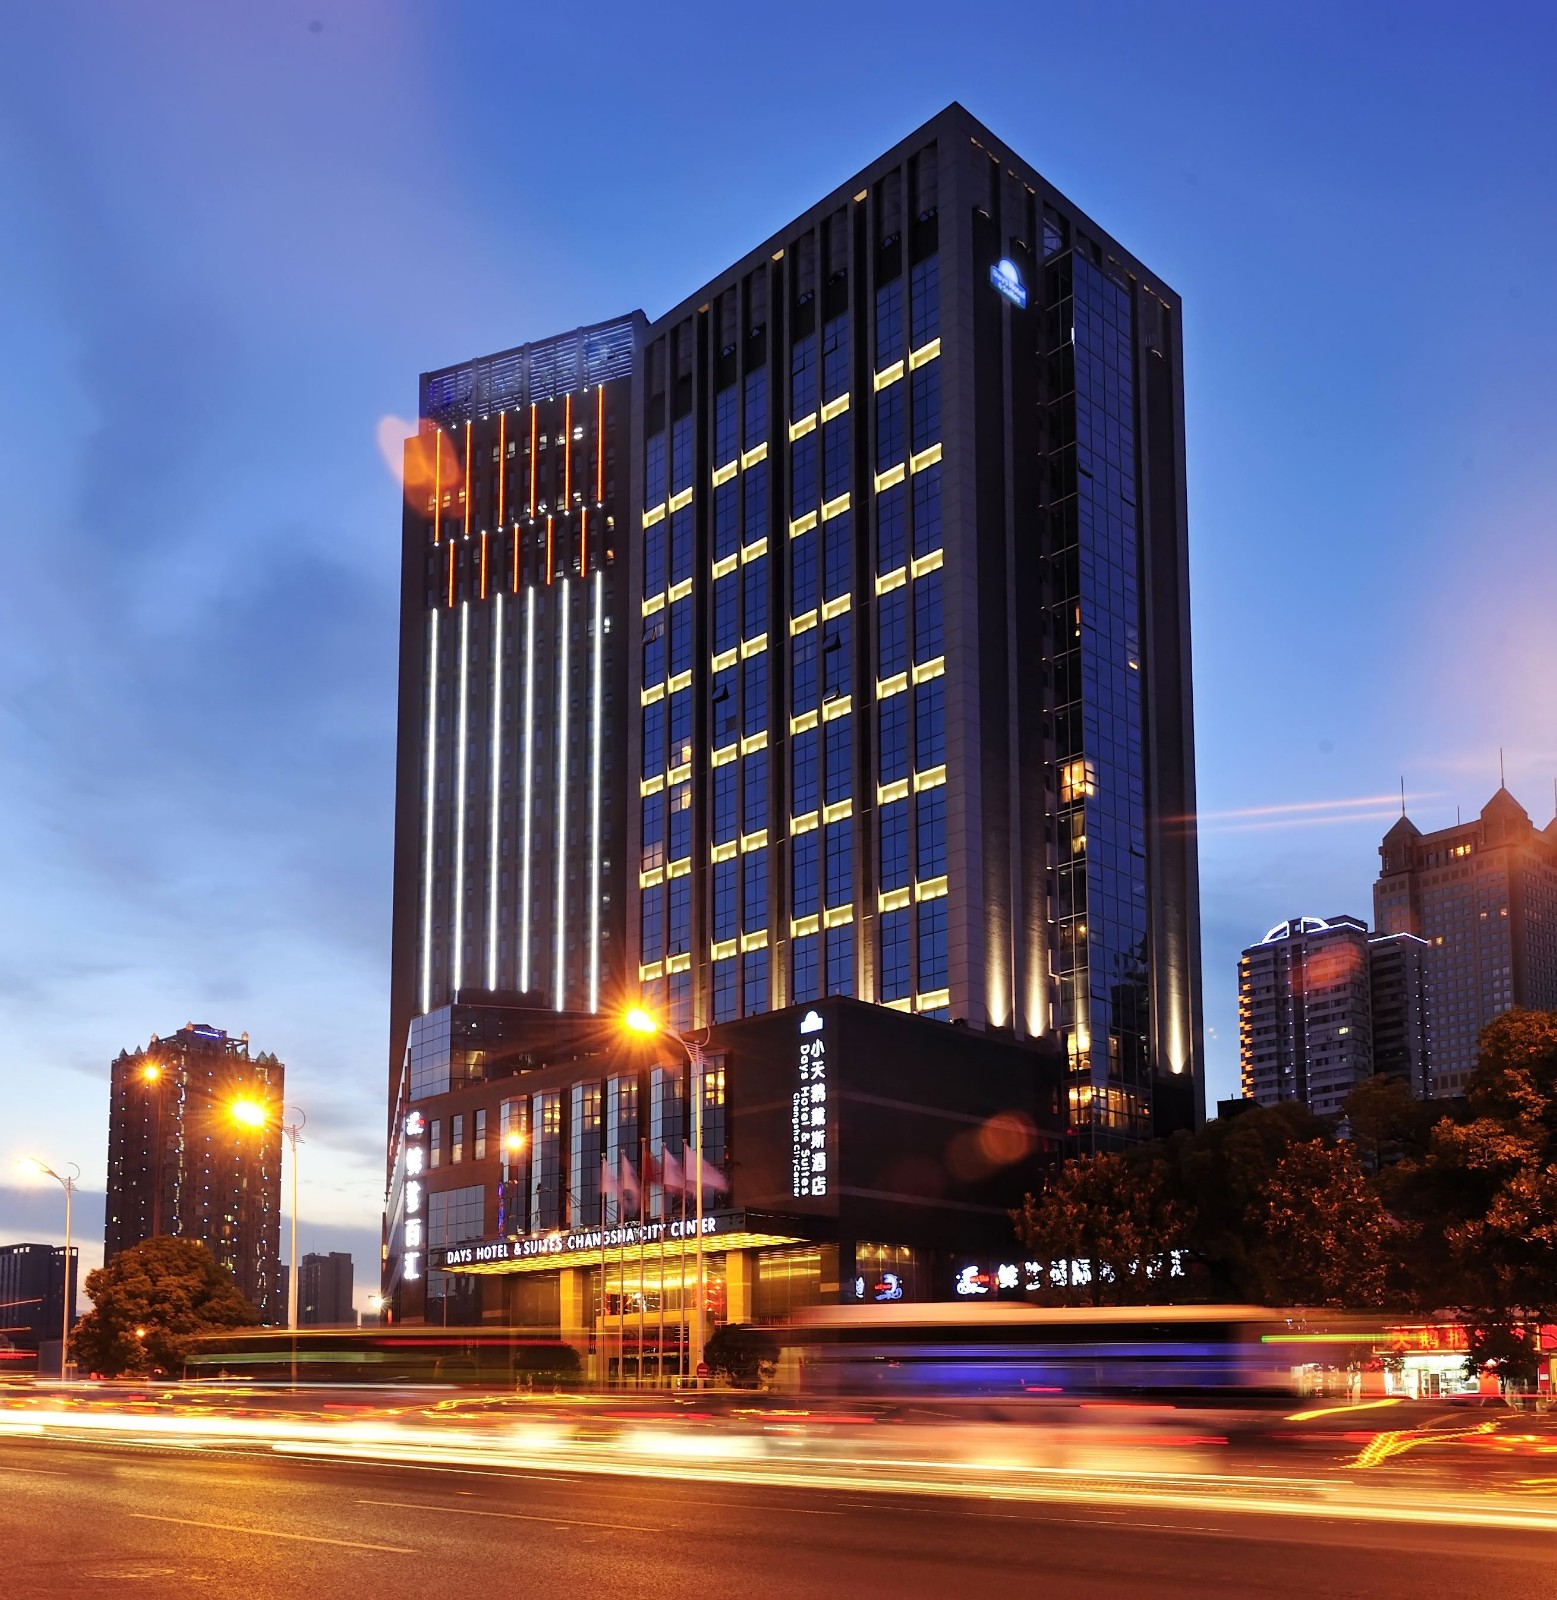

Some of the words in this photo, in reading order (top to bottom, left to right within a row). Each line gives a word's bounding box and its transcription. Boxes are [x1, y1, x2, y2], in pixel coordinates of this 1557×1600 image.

[799, 1044, 810, 1080] Days
[792, 1092, 800, 1142] Changsha
[800, 1086, 810, 1126] Hotel
[800, 1132, 810, 1143] &
[800, 1149, 810, 1196] Suites
[447, 1248, 472, 1264] DAYS
[476, 1244, 508, 1260] HOTEL
[523, 1237, 563, 1255] SUITES
[567, 1227, 635, 1250] CHANGSHA
[639, 1223, 667, 1241] CITY
[670, 1217, 717, 1238] CNER
